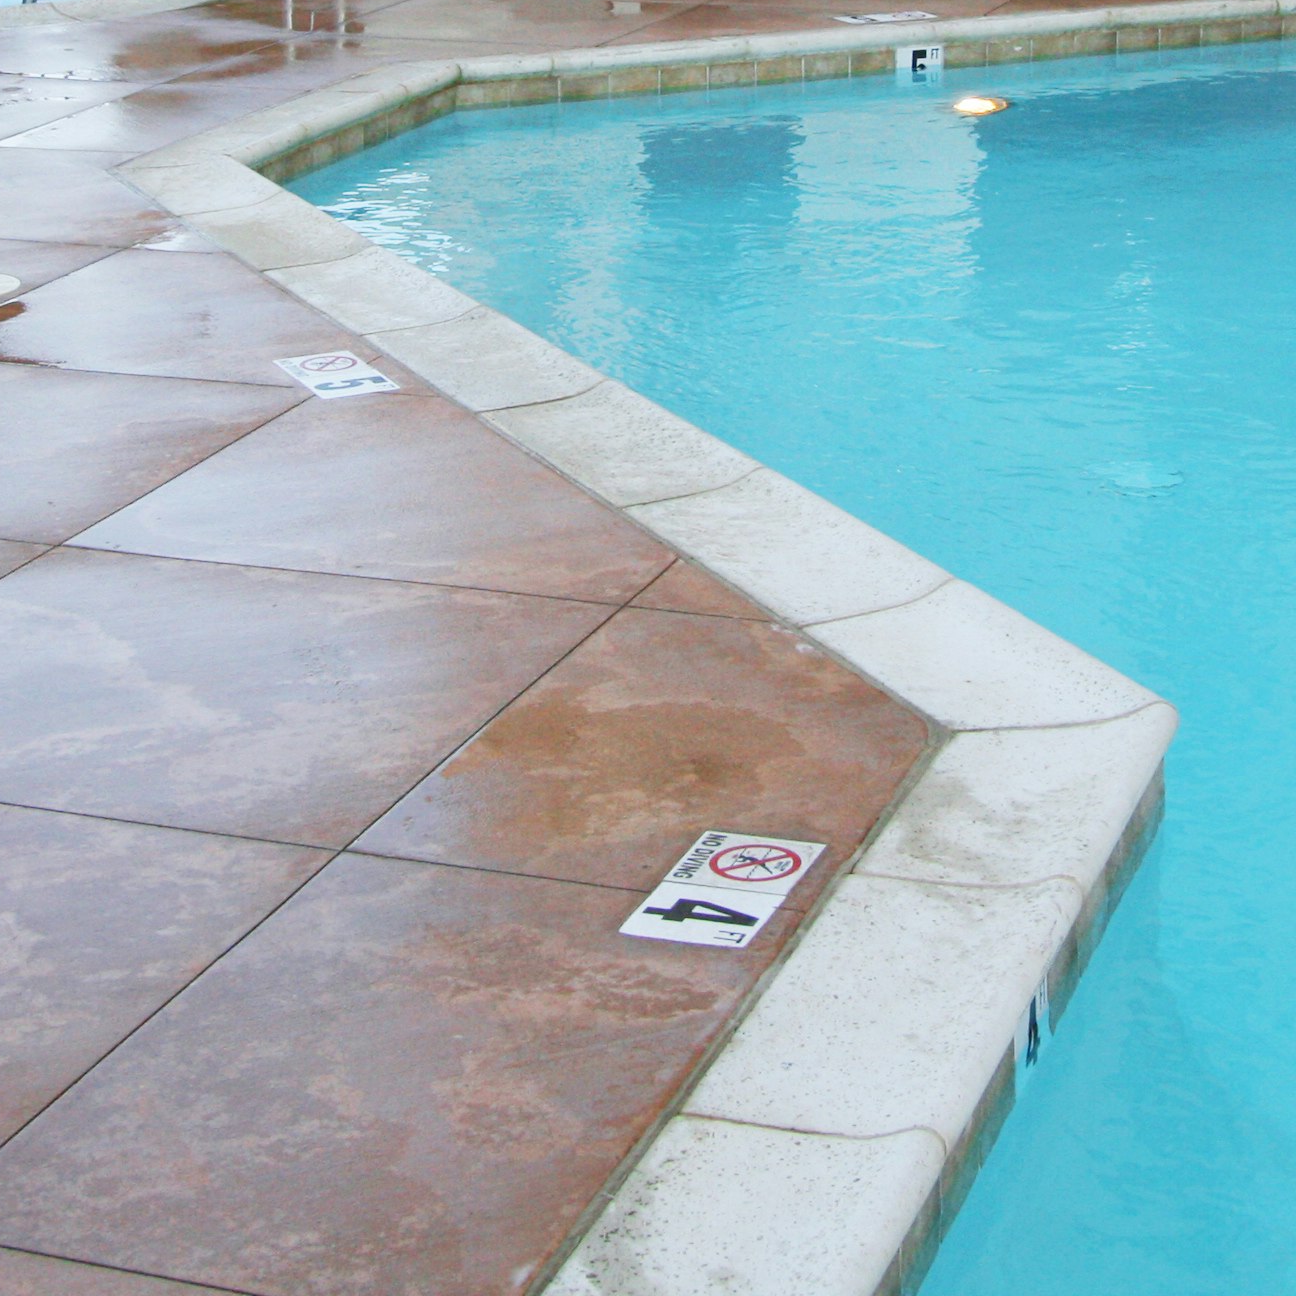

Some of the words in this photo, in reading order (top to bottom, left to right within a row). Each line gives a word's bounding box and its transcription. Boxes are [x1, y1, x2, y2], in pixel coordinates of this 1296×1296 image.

[911, 49, 927, 72] 5
[931, 48, 939, 59] FT
[701, 833, 728, 847] NO
[672, 847, 714, 879] DIVING
[642, 898, 760, 927] 4
[713, 930, 746, 944] FT
